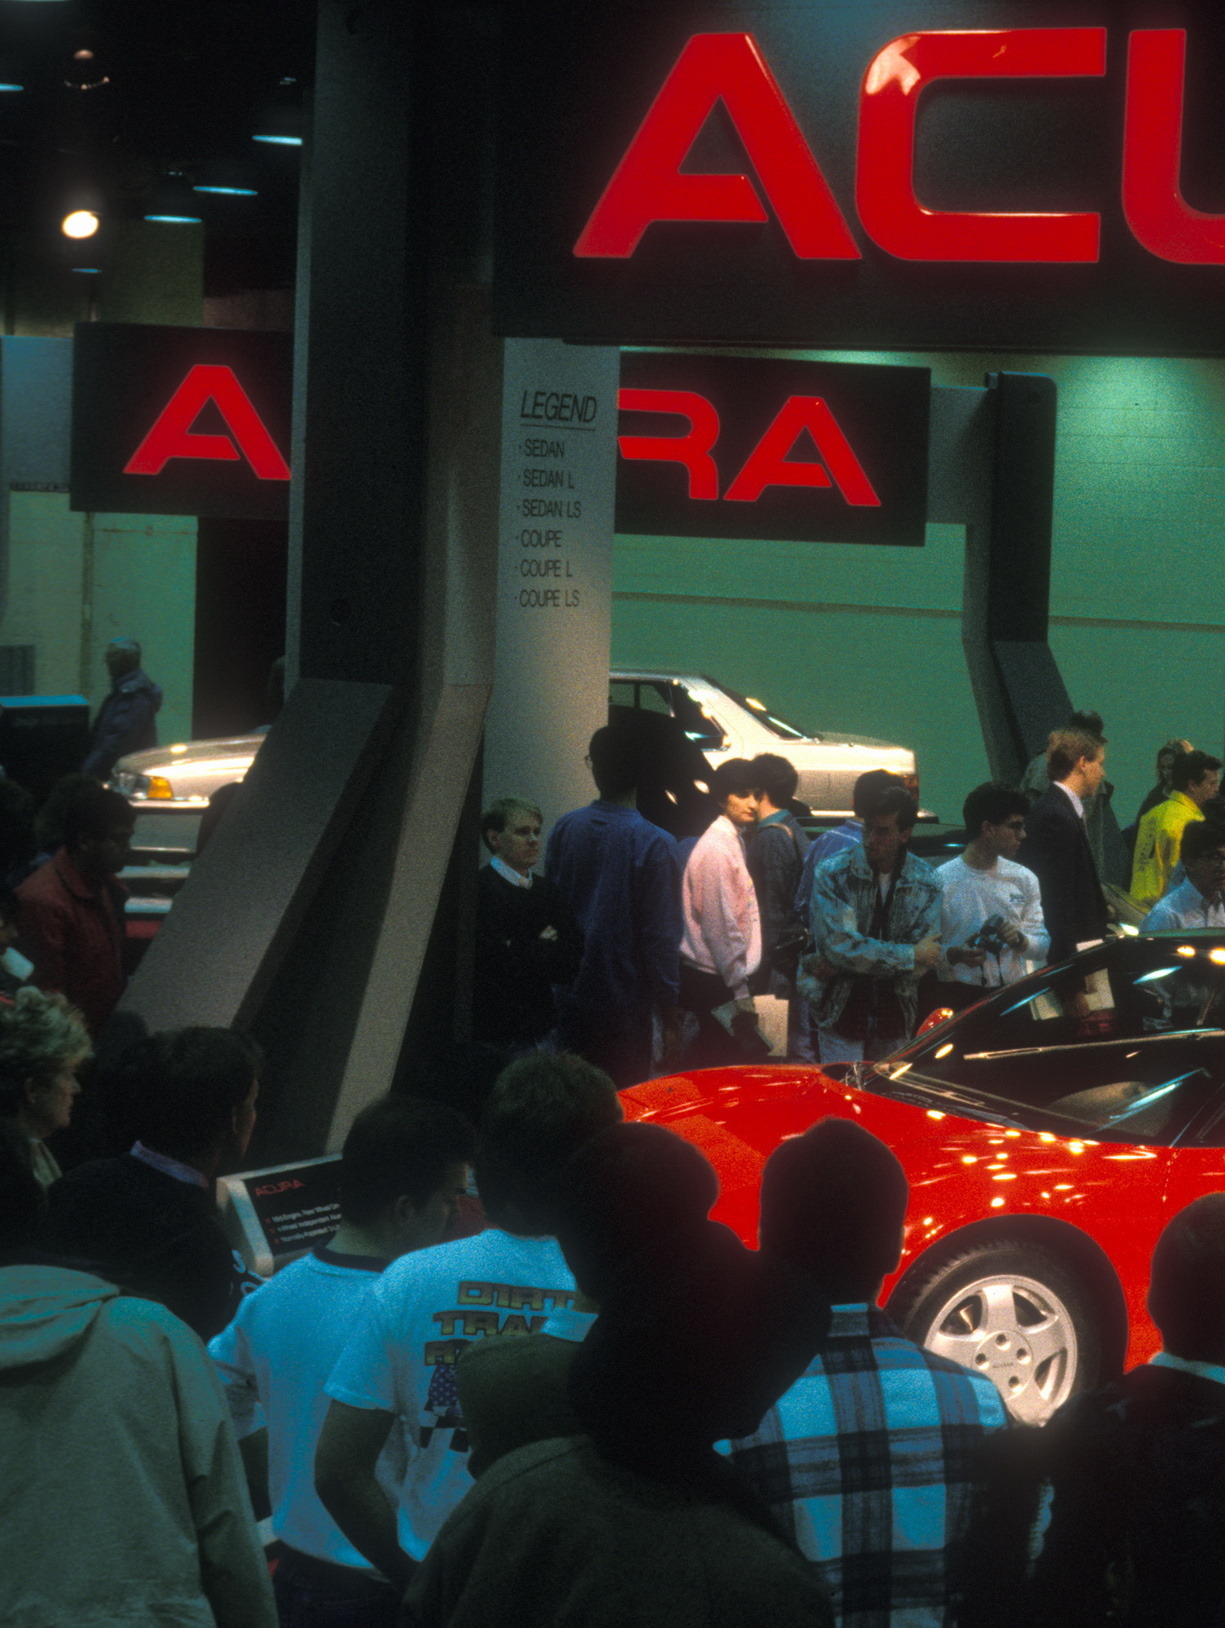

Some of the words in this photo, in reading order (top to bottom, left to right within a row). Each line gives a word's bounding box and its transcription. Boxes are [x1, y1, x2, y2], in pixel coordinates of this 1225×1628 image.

[519, 390, 598, 423] LEGEND
[523, 438, 565, 459] SEDAN
[522, 469, 564, 488] SEDAN
[567, 471, 575, 490] L
[521, 499, 563, 518] SEDAN
[566, 501, 582, 519] LS
[520, 529, 562, 548] COUPE
[520, 559, 561, 578] COUPE
[566, 560, 573, 578] L
[519, 589, 560, 608] COUPE
[564, 589, 580, 607] LS
[255, 1180, 304, 1196] ACURA
[457, 1280, 580, 1313] DIRT
